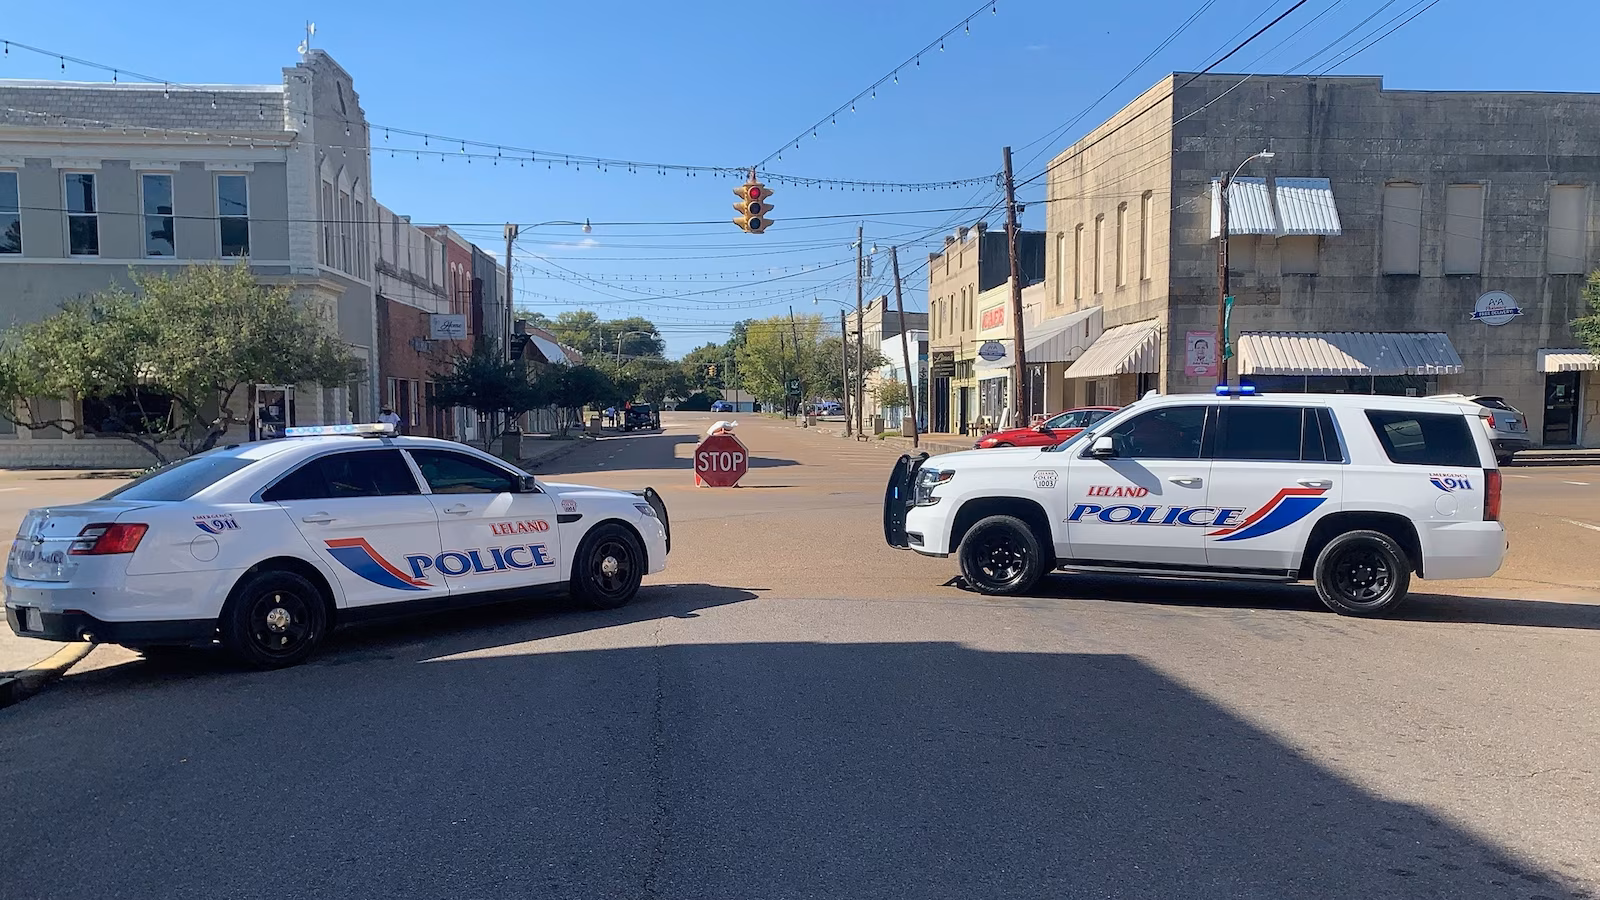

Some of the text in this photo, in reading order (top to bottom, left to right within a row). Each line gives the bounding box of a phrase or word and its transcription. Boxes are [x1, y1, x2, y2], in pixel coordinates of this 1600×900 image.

[698, 451, 744, 472] STOP
[1086, 485, 1149, 499] LELAND
[1444, 478, 1474, 490] 911
[1063, 503, 1247, 528] POLICE
[211, 519, 242, 531] 911
[489, 519, 550, 537] LELAND
[404, 543, 556, 580] POLICE
